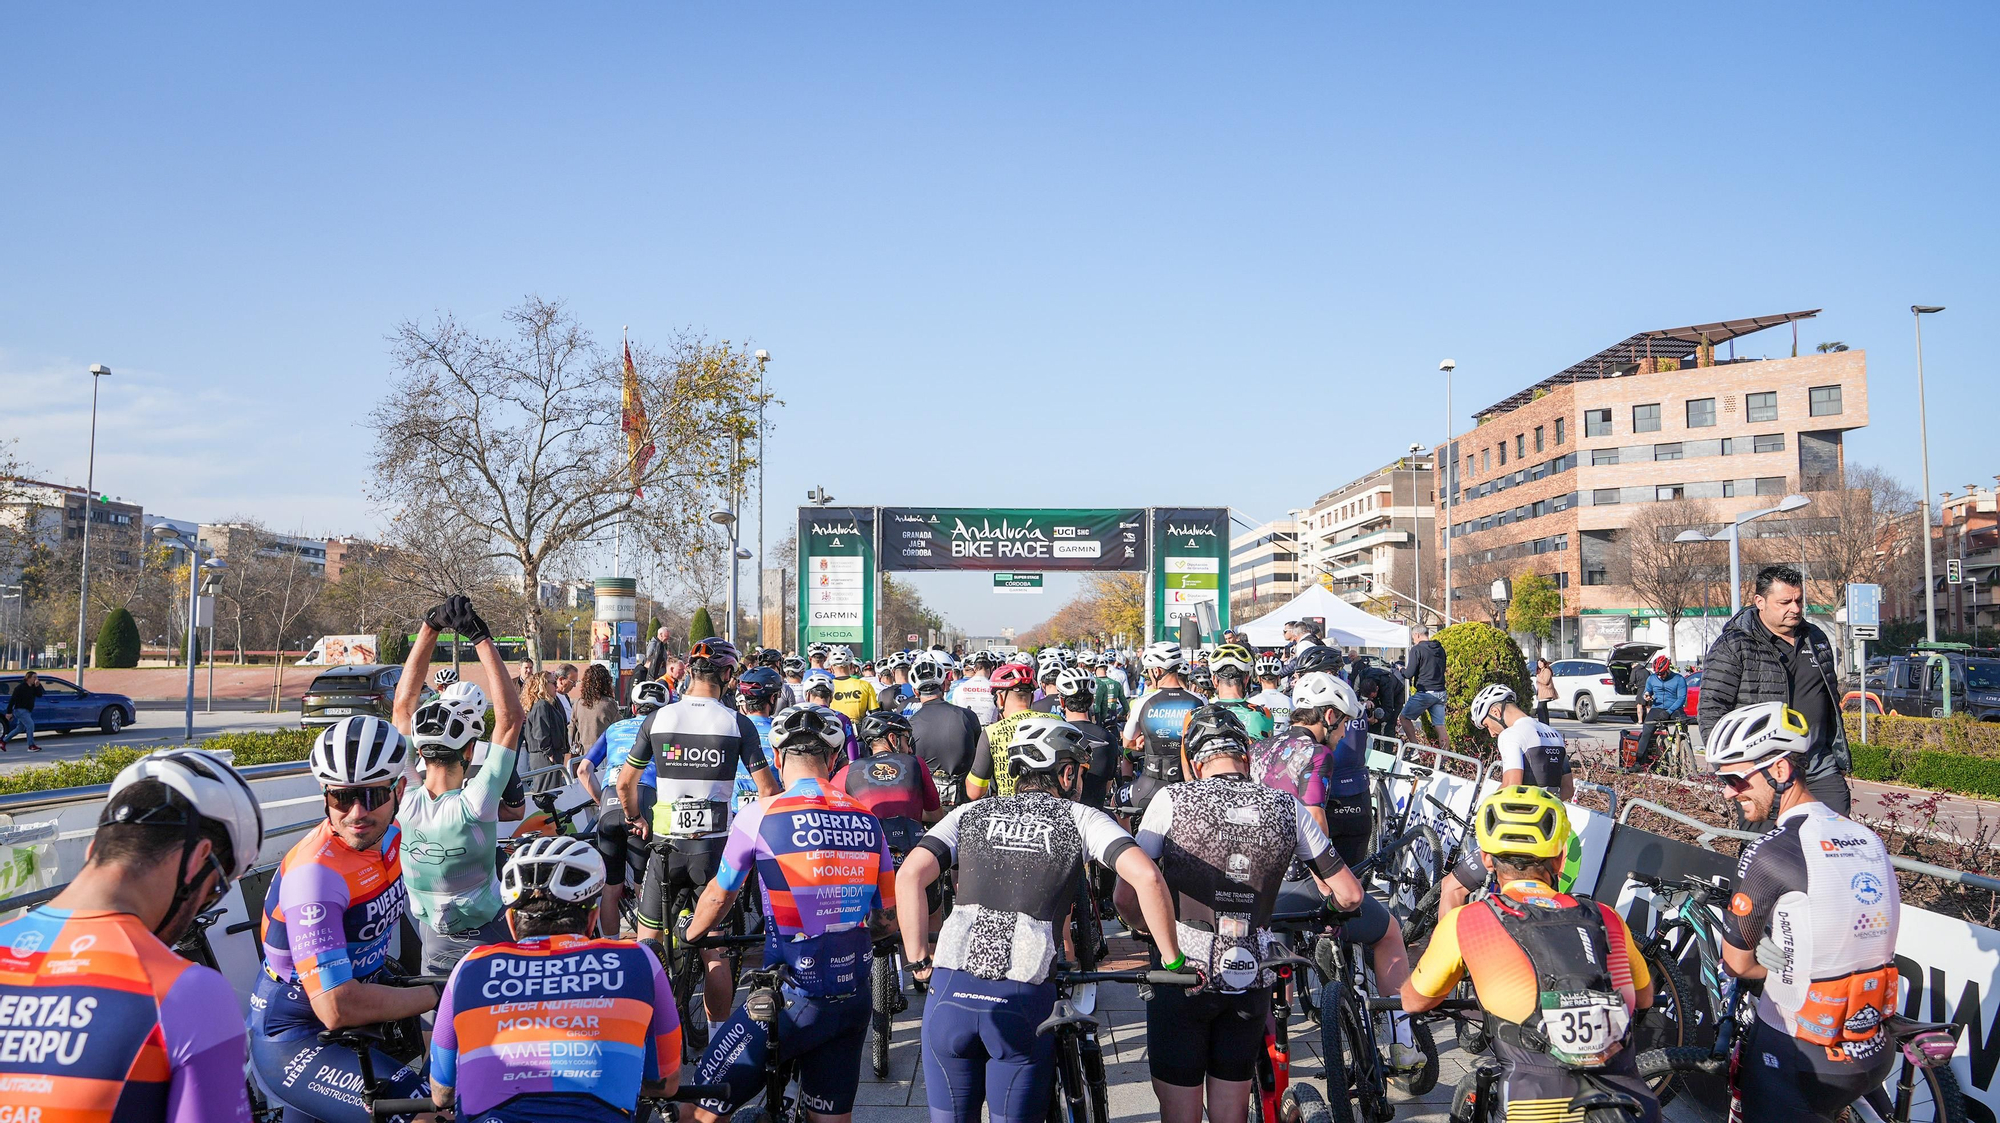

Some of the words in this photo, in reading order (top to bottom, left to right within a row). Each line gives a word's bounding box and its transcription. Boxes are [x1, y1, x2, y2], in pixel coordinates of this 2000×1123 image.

[895, 514, 924, 522] Andalucía
[812, 523, 860, 536] Andalucía
[902, 531, 932, 539] GRANADA
[950, 517, 1048, 542] Andalucía
[1167, 524, 1216, 536] Andalucía
[902, 548, 932, 556] CÓRDOBA
[908, 539, 926, 548] JAÉN
[952, 541, 994, 558] BIKE
[998, 541, 1050, 558] RACE
[1746, 728, 1778, 750] SCOTT
[677, 810, 705, 828] 48-2
[792, 812, 872, 830] PUERTAS
[792, 830, 876, 848] COFERPU
[982, 815, 1054, 854] TALLER
[836, 849, 870, 860] NUTRICIÓN
[813, 866, 864, 878] MONGAR
[366, 877, 411, 922] PUERTA
[358, 902, 405, 941] COFER
[1778, 911, 1794, 946] D-ROUTE
[292, 935, 334, 953] HERENA
[295, 928, 333, 942] DANIEL
[490, 952, 620, 979] PUERTAS
[830, 953, 856, 964] PALOMINO
[482, 970, 624, 999] COFERPU
[490, 1000, 537, 1016] LIÉTOR
[541, 995, 615, 1011] NUTRICIÓN
[952, 992, 1008, 1004] MONDRAKER
[0, 995, 98, 1028] ERTAS
[498, 1015, 600, 1033] MONGAR
[1560, 1009, 1612, 1044] 35-1
[566, 1030, 600, 1038] GROUP
[500, 1042, 602, 1060] AMEDIDA
[701, 1022, 736, 1081] PALOMINO
[282, 1045, 324, 1088] LIEBANA
[284, 1046, 311, 1075] AJOS
[315, 1065, 364, 1093] PALOMI
[503, 1069, 603, 1082] BALDUBIKE
[308, 1081, 367, 1108] CONSTRUCCION
